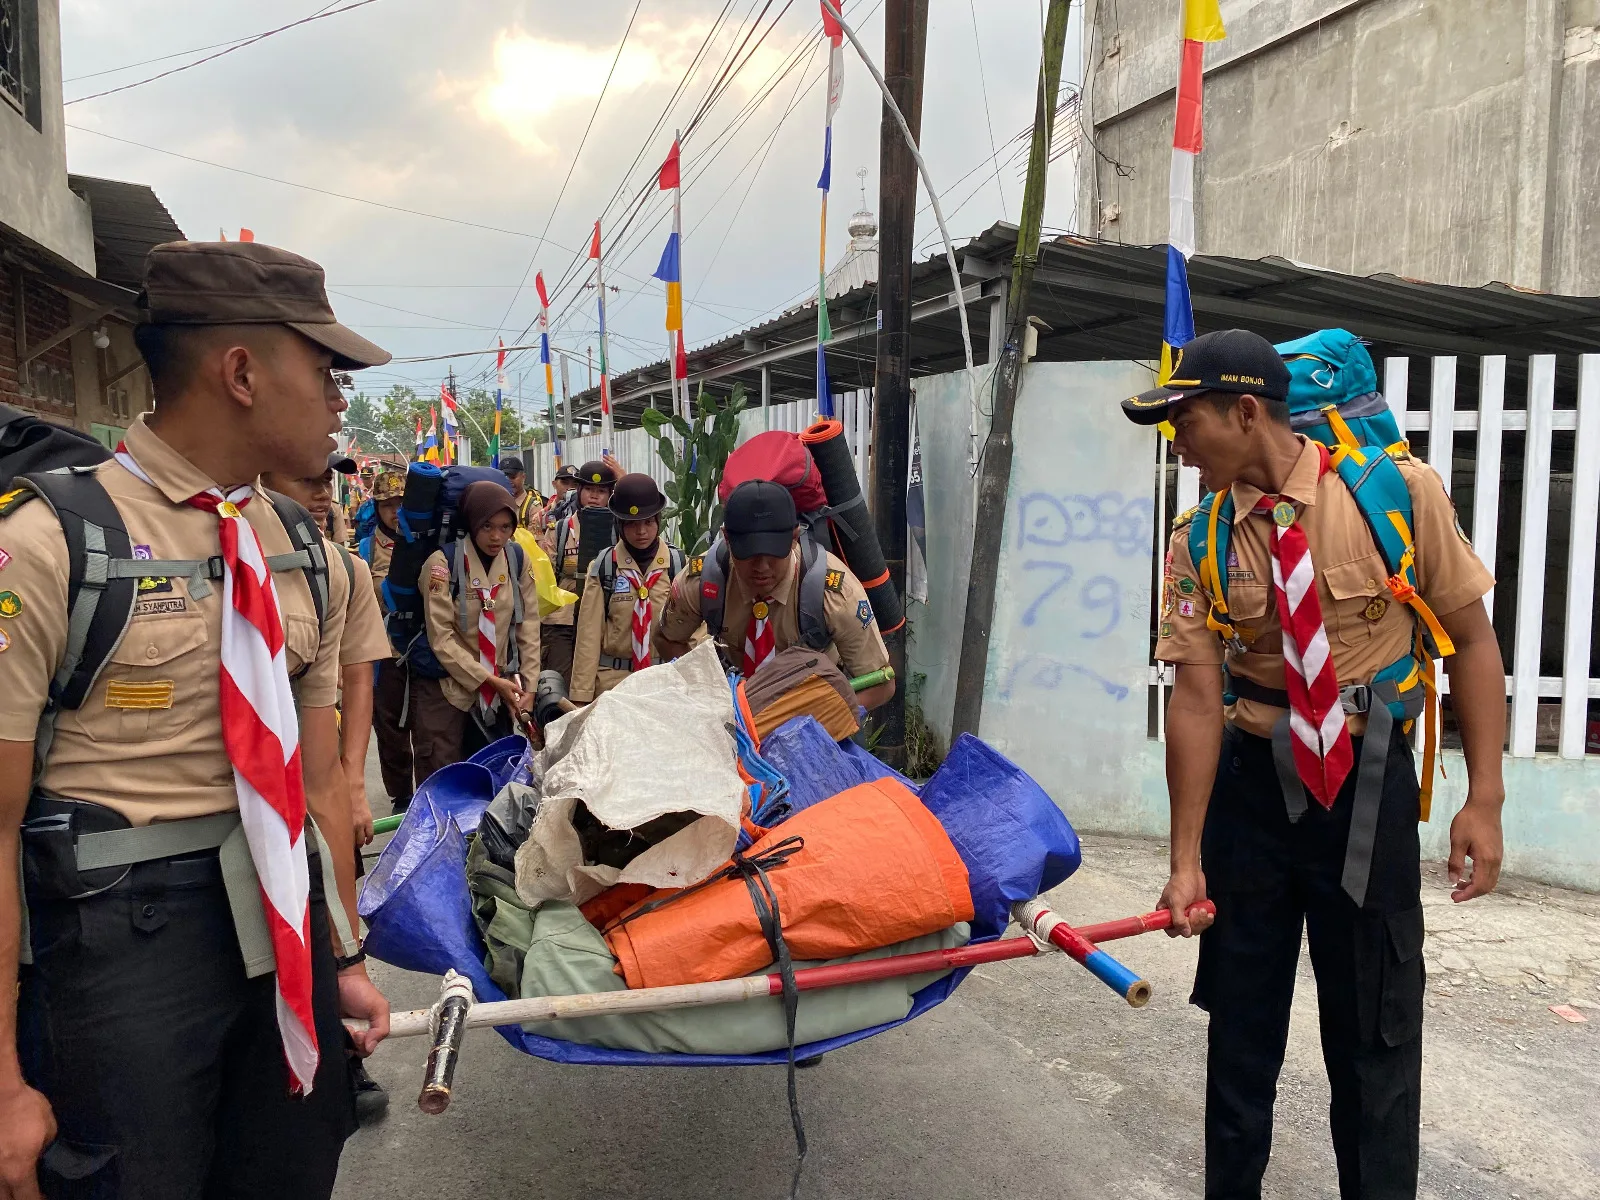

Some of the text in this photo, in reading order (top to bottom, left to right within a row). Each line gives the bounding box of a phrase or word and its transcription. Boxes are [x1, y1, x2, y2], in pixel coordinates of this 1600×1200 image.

[1220, 374, 1265, 386] IMAM BONJOL
[1021, 559, 1121, 638] 79
[143, 600, 183, 611] SYAHPUTRA
